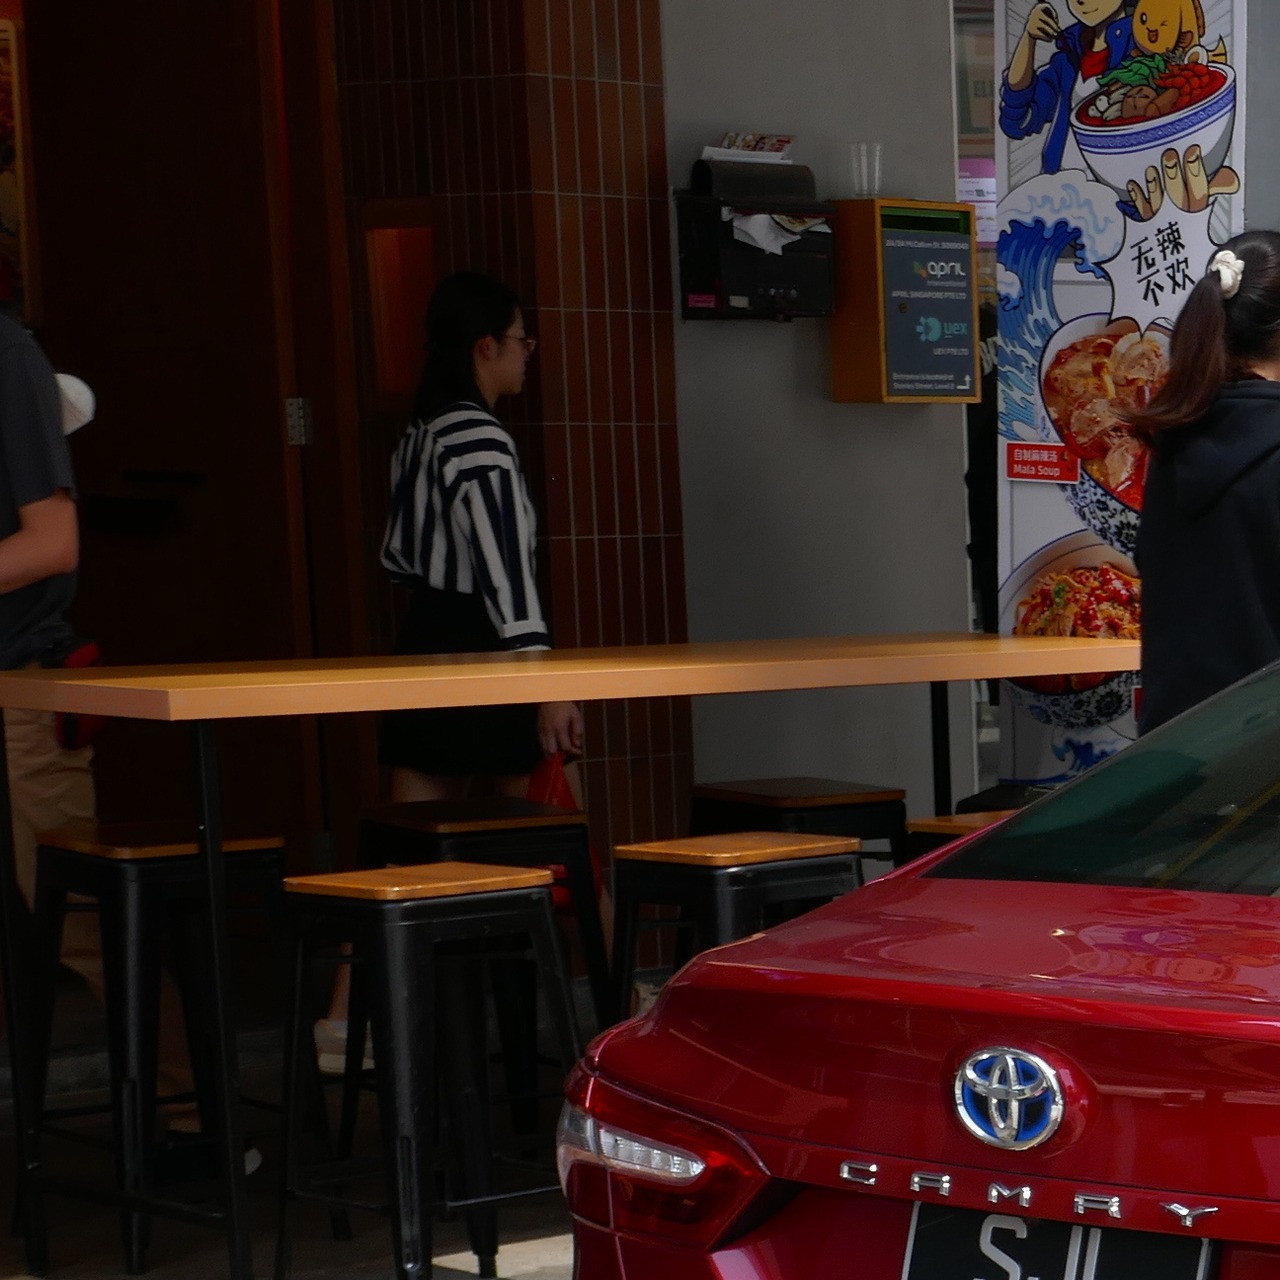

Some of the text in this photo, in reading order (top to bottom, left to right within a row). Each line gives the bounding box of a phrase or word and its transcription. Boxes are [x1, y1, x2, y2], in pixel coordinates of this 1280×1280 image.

[1130, 221, 1185, 275] 无辣
[927, 261, 967, 278] april
[1137, 257, 1196, 307] 不欢
[944, 322, 968, 338] uex
[1013, 464, 1060, 477] Mala Soup
[840, 1161, 1219, 1227] CAMRY
